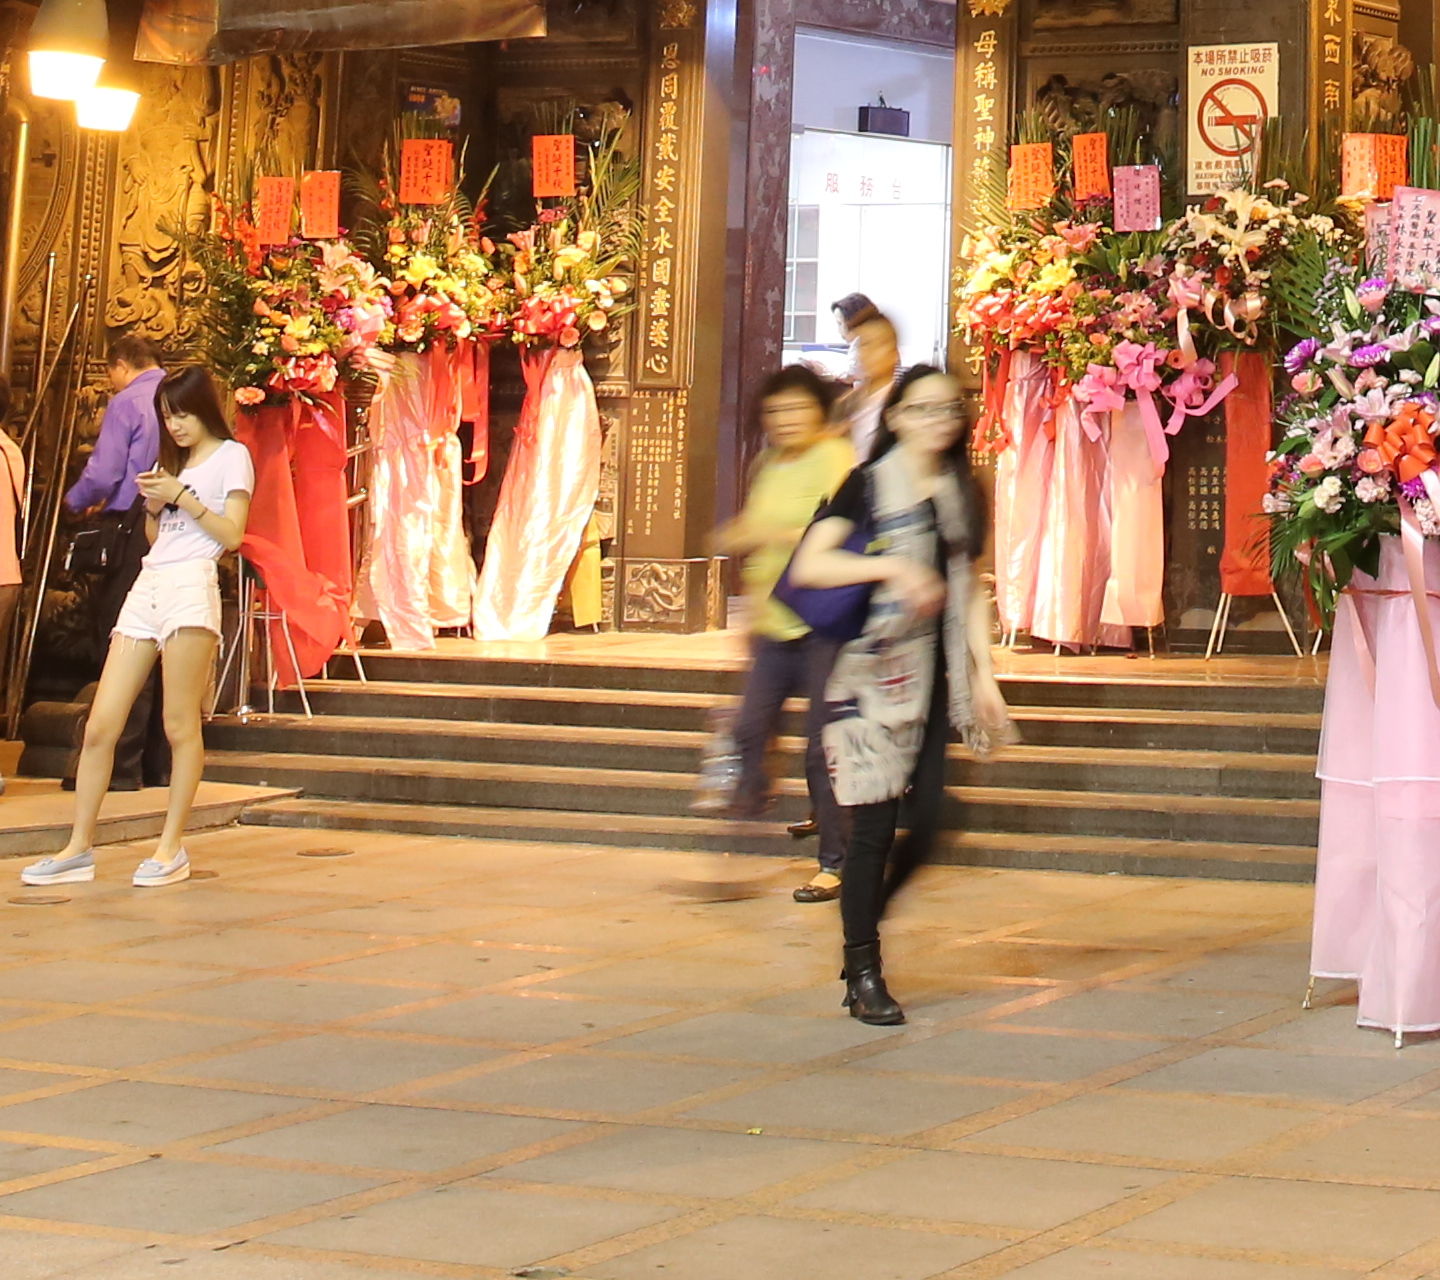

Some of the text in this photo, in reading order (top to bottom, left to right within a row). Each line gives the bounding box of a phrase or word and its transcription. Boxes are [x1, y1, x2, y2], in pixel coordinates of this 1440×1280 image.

[1194, 48, 1273, 65] 本場所禁止吸菸
[1201, 66, 1265, 77] NO SMOKING
[825, 172, 905, 200] 服務台
[1418, 209, 1437, 274] 聖誕千秋
